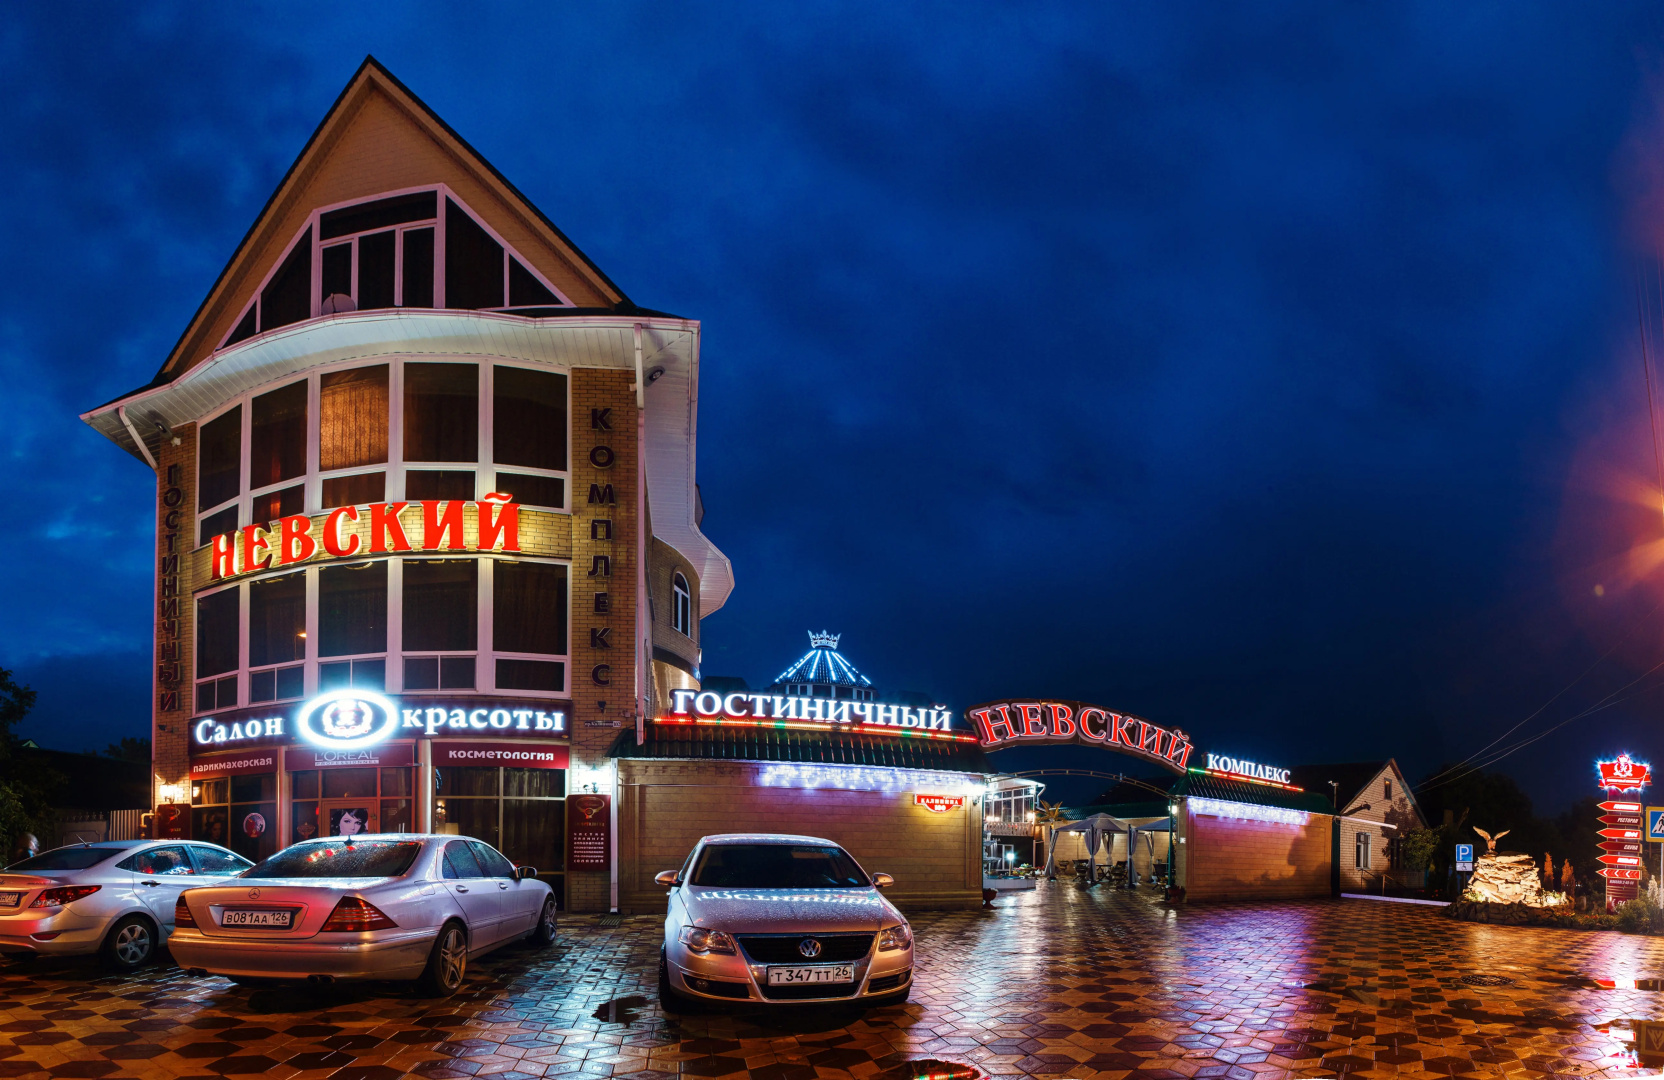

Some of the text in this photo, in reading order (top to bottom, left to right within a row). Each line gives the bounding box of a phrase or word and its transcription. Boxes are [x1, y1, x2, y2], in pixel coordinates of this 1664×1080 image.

[210, 492, 521, 580] НЕВСКИЙ
[587, 408, 616, 686] КОМПЛЕКС
[159, 464, 182, 712] ГОСТИНИЧНЫЙ
[196, 707, 564, 744] Салон красоты
[674, 691, 951, 731] ГОСТИНИЧНЫЙ
[976, 703, 1193, 769] НЕВСКИЙ
[193, 757, 272, 773] парикмахерская
[448, 750, 554, 761] косметология
[1206, 753, 1291, 784] КОМПЛЕКС
[270, 912, 287, 921] 126
[835, 966, 848, 976] 26
